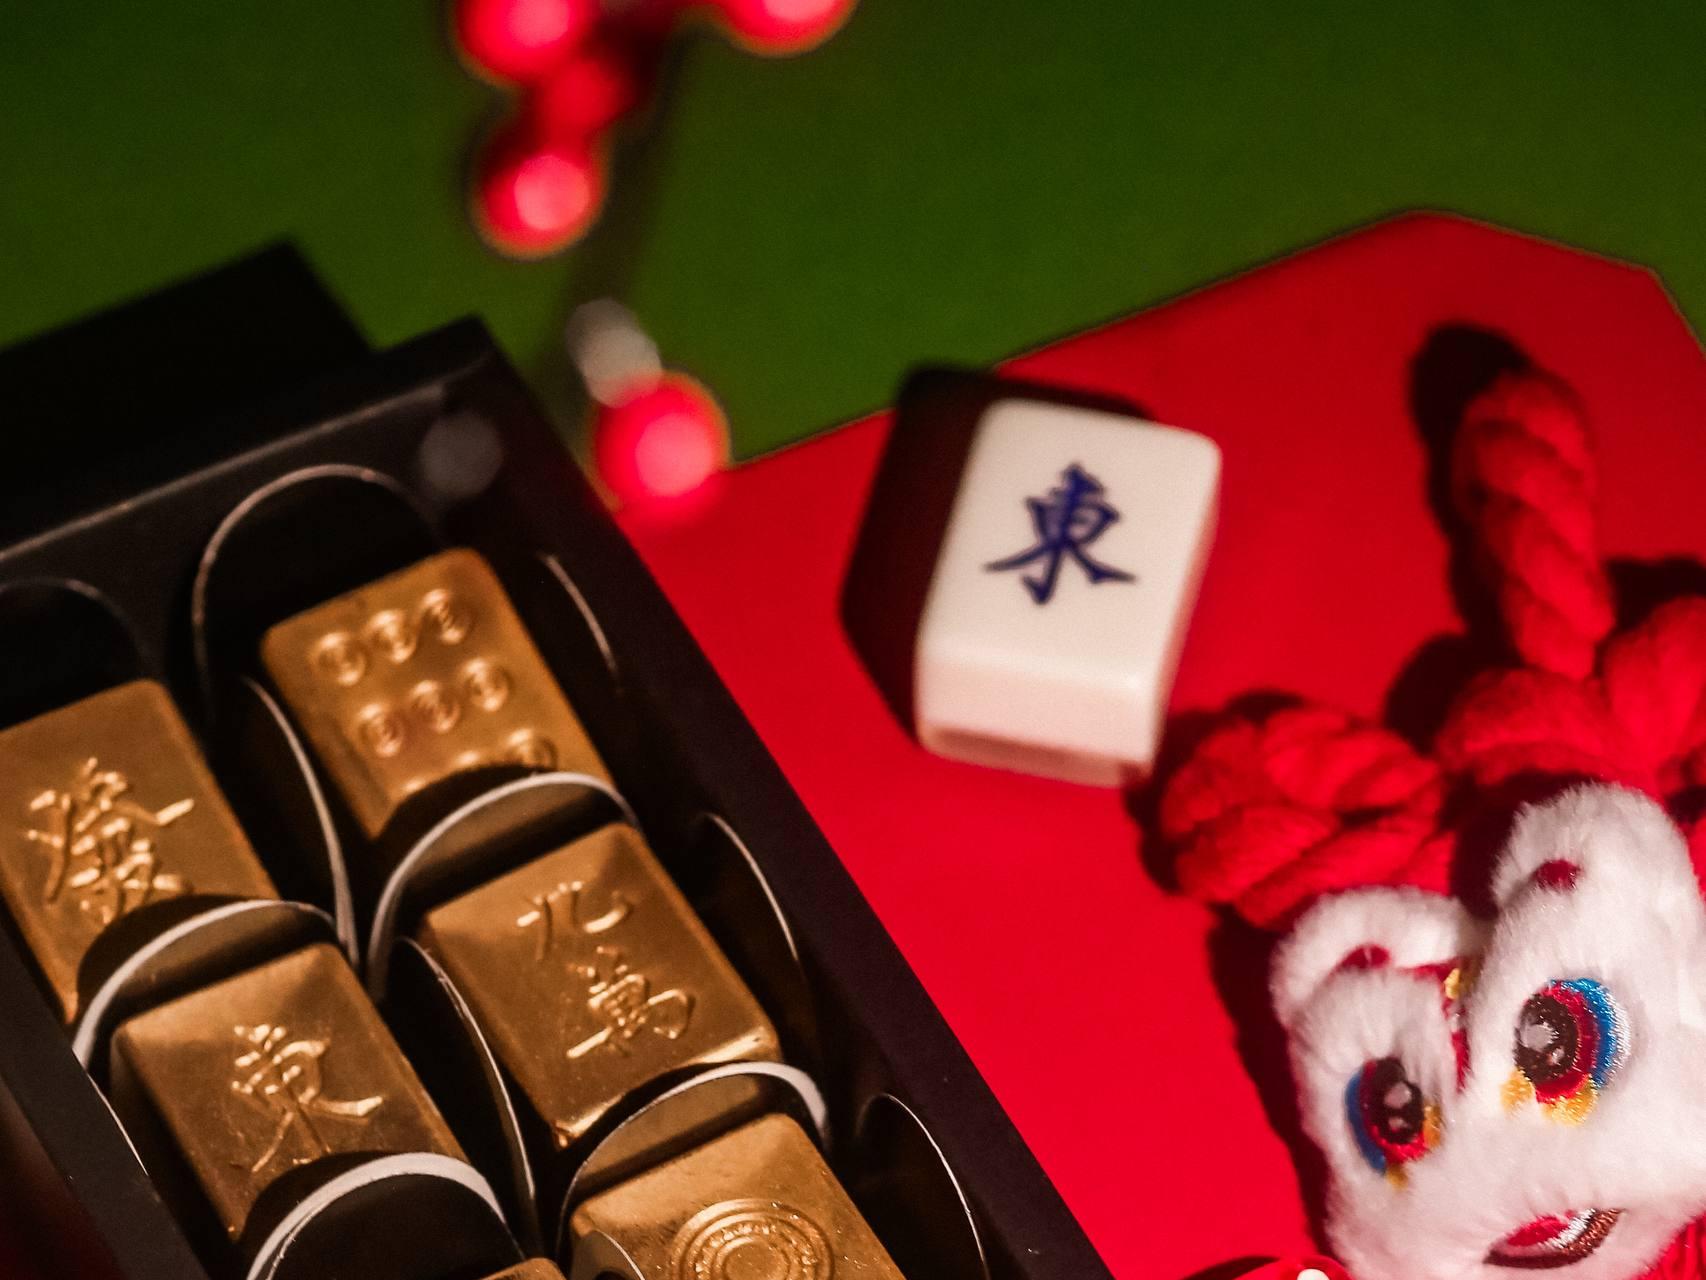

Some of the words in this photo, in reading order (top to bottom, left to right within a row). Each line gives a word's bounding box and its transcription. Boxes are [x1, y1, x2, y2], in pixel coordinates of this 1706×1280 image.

[984, 463, 1136, 605] 東
[24, 756, 194, 924] 發
[515, 880, 695, 1059] 九萬
[232, 1023, 383, 1174] 東
